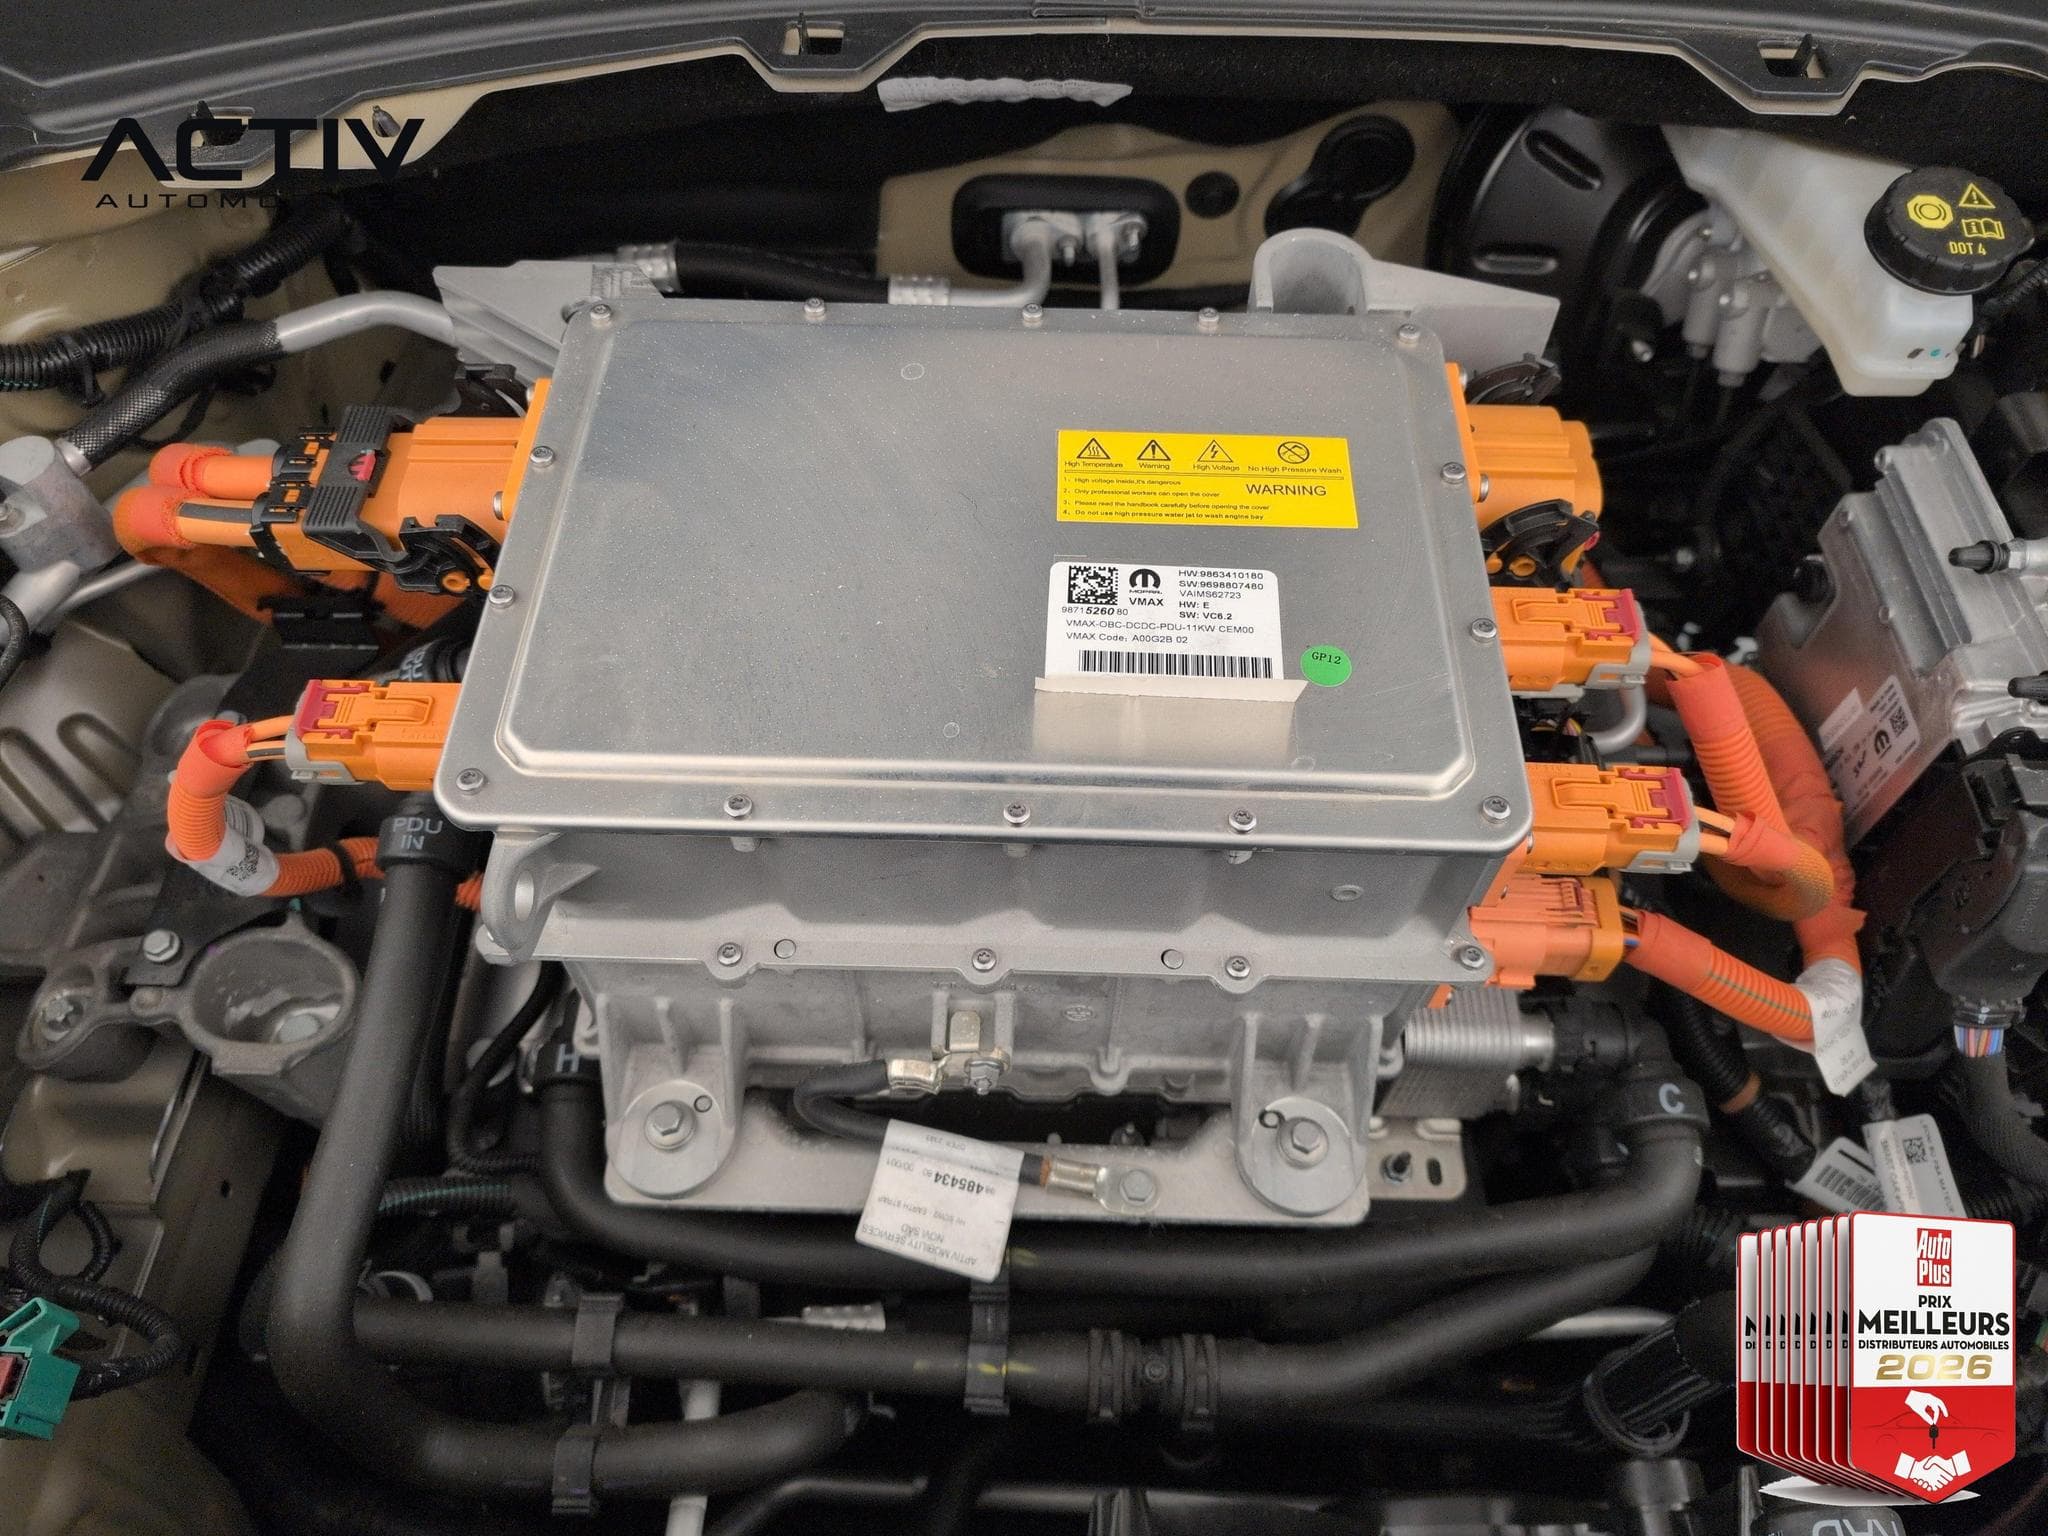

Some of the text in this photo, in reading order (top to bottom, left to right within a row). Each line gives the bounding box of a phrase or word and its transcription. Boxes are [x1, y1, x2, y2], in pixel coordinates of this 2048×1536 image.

[1949, 241, 1987, 255] DOT 4
[1081, 461, 1124, 469] Temperature
[1074, 488, 1089, 496] Only
[1246, 483, 1327, 497] WARNING
[1211, 503, 1238, 511] opening
[1114, 510, 1130, 518] high
[1224, 513, 1249, 521] engine
[1180, 590, 1241, 599] VAIMS62723
[1129, 597, 1164, 606] VMAX
[1178, 601, 1210, 609] HW: E
[1178, 611, 1233, 620] SW: VC6.2
[1066, 632, 1096, 641] VMAX
[1175, 636, 1188, 644] 02
[1311, 652, 1342, 665] GP12
[392, 814, 443, 835] PDU
[400, 833, 425, 852] IN
[555, 1047, 579, 1072] H
[1658, 1082, 1684, 1115] C
[861, 1223, 907, 1245] SERVICES
[921, 1228, 945, 1244] NOVI
[907, 1239, 952, 1259] MOBILITY
